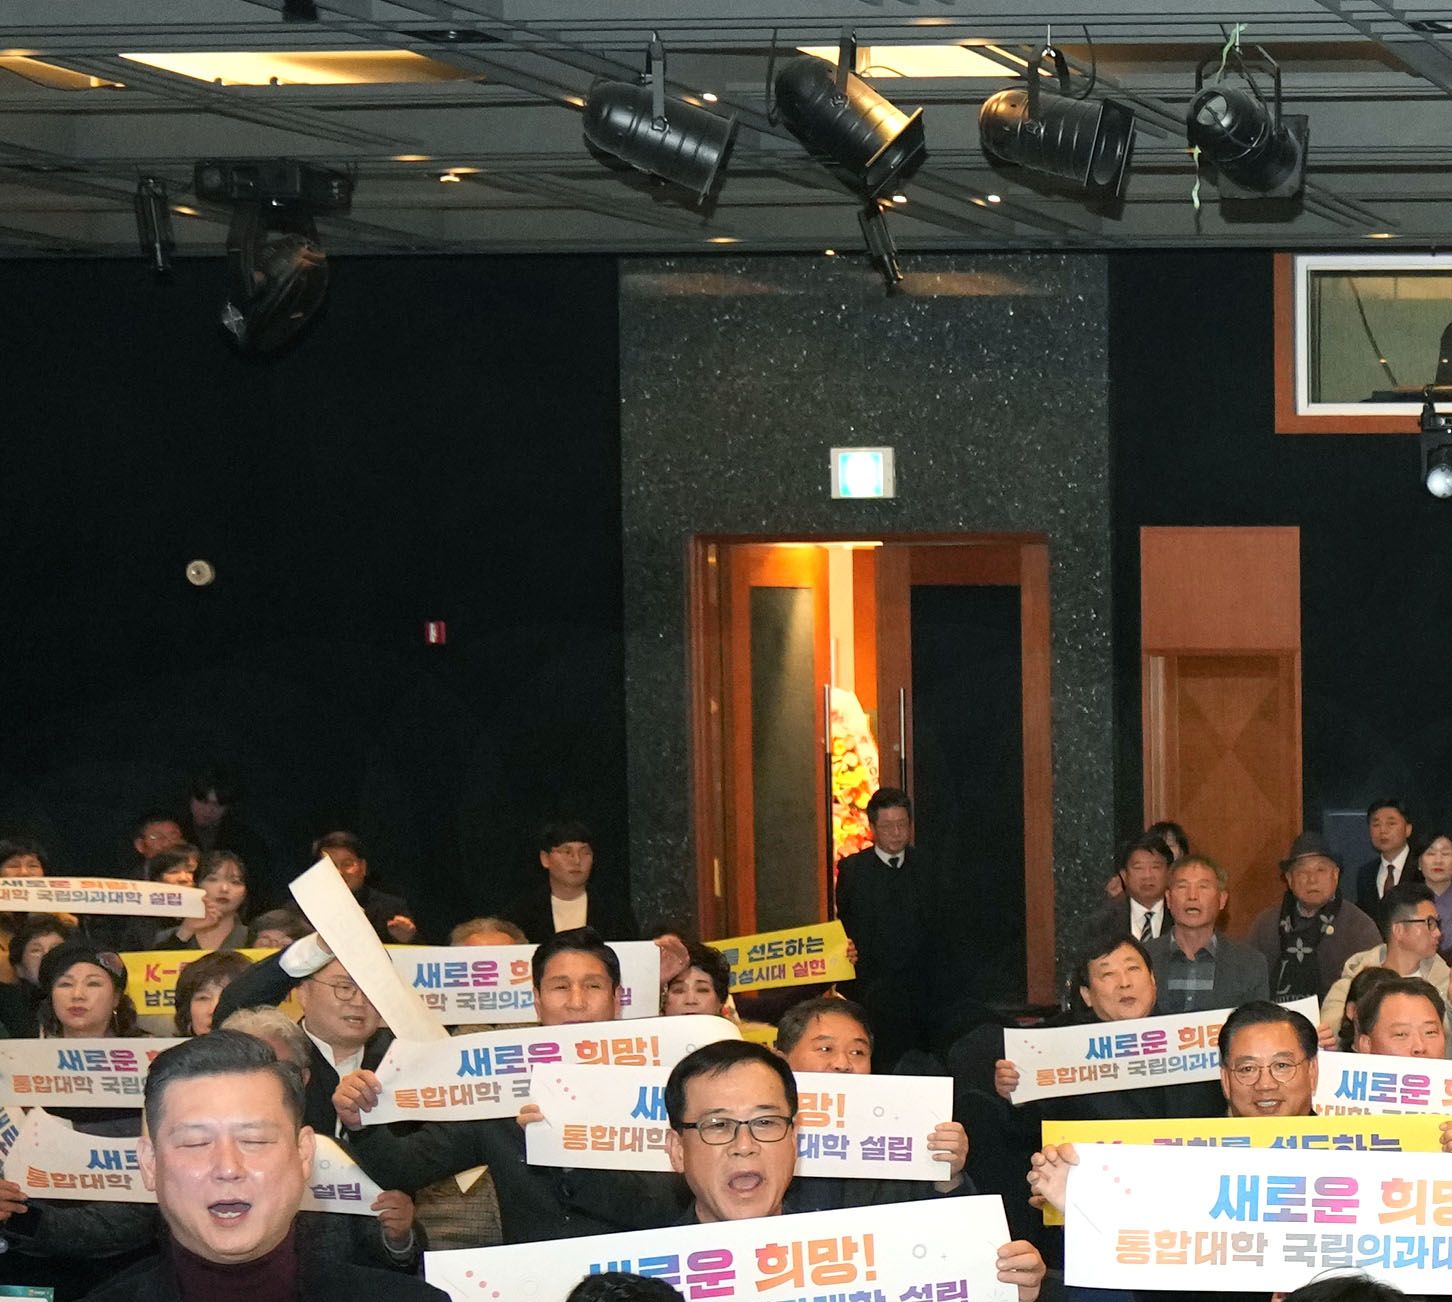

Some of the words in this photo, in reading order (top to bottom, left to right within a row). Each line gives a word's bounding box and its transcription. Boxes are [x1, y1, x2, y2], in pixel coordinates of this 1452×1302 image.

[37, 889, 143, 905] 국립의과대학
[149, 891, 182, 907] 설립
[746, 935, 825, 965] 선도하는
[413, 960, 499, 989] 새로운
[793, 958, 828, 977] 실현
[455, 989, 533, 1011] 국립의과
[456, 1041, 563, 1077] 새로운
[575, 1035, 661, 1065] 희망!
[1085, 1029, 1168, 1061] 새로운
[57, 1050, 139, 1072] 새로운
[1036, 1062, 1120, 1087] 통합대학
[12, 1074, 94, 1095] 통합대학
[394, 1078, 501, 1109] 통합대학
[1333, 1069, 1431, 1107] 새로운
[797, 1092, 847, 1128] 망!
[859, 1136, 913, 1162] 설립
[26, 1165, 133, 1191] 통합대학
[309, 1181, 362, 1201] 설립
[1208, 1173, 1360, 1224] 새로운
[1114, 1228, 1268, 1267] 통합대학
[754, 1233, 877, 1293] 희망!
